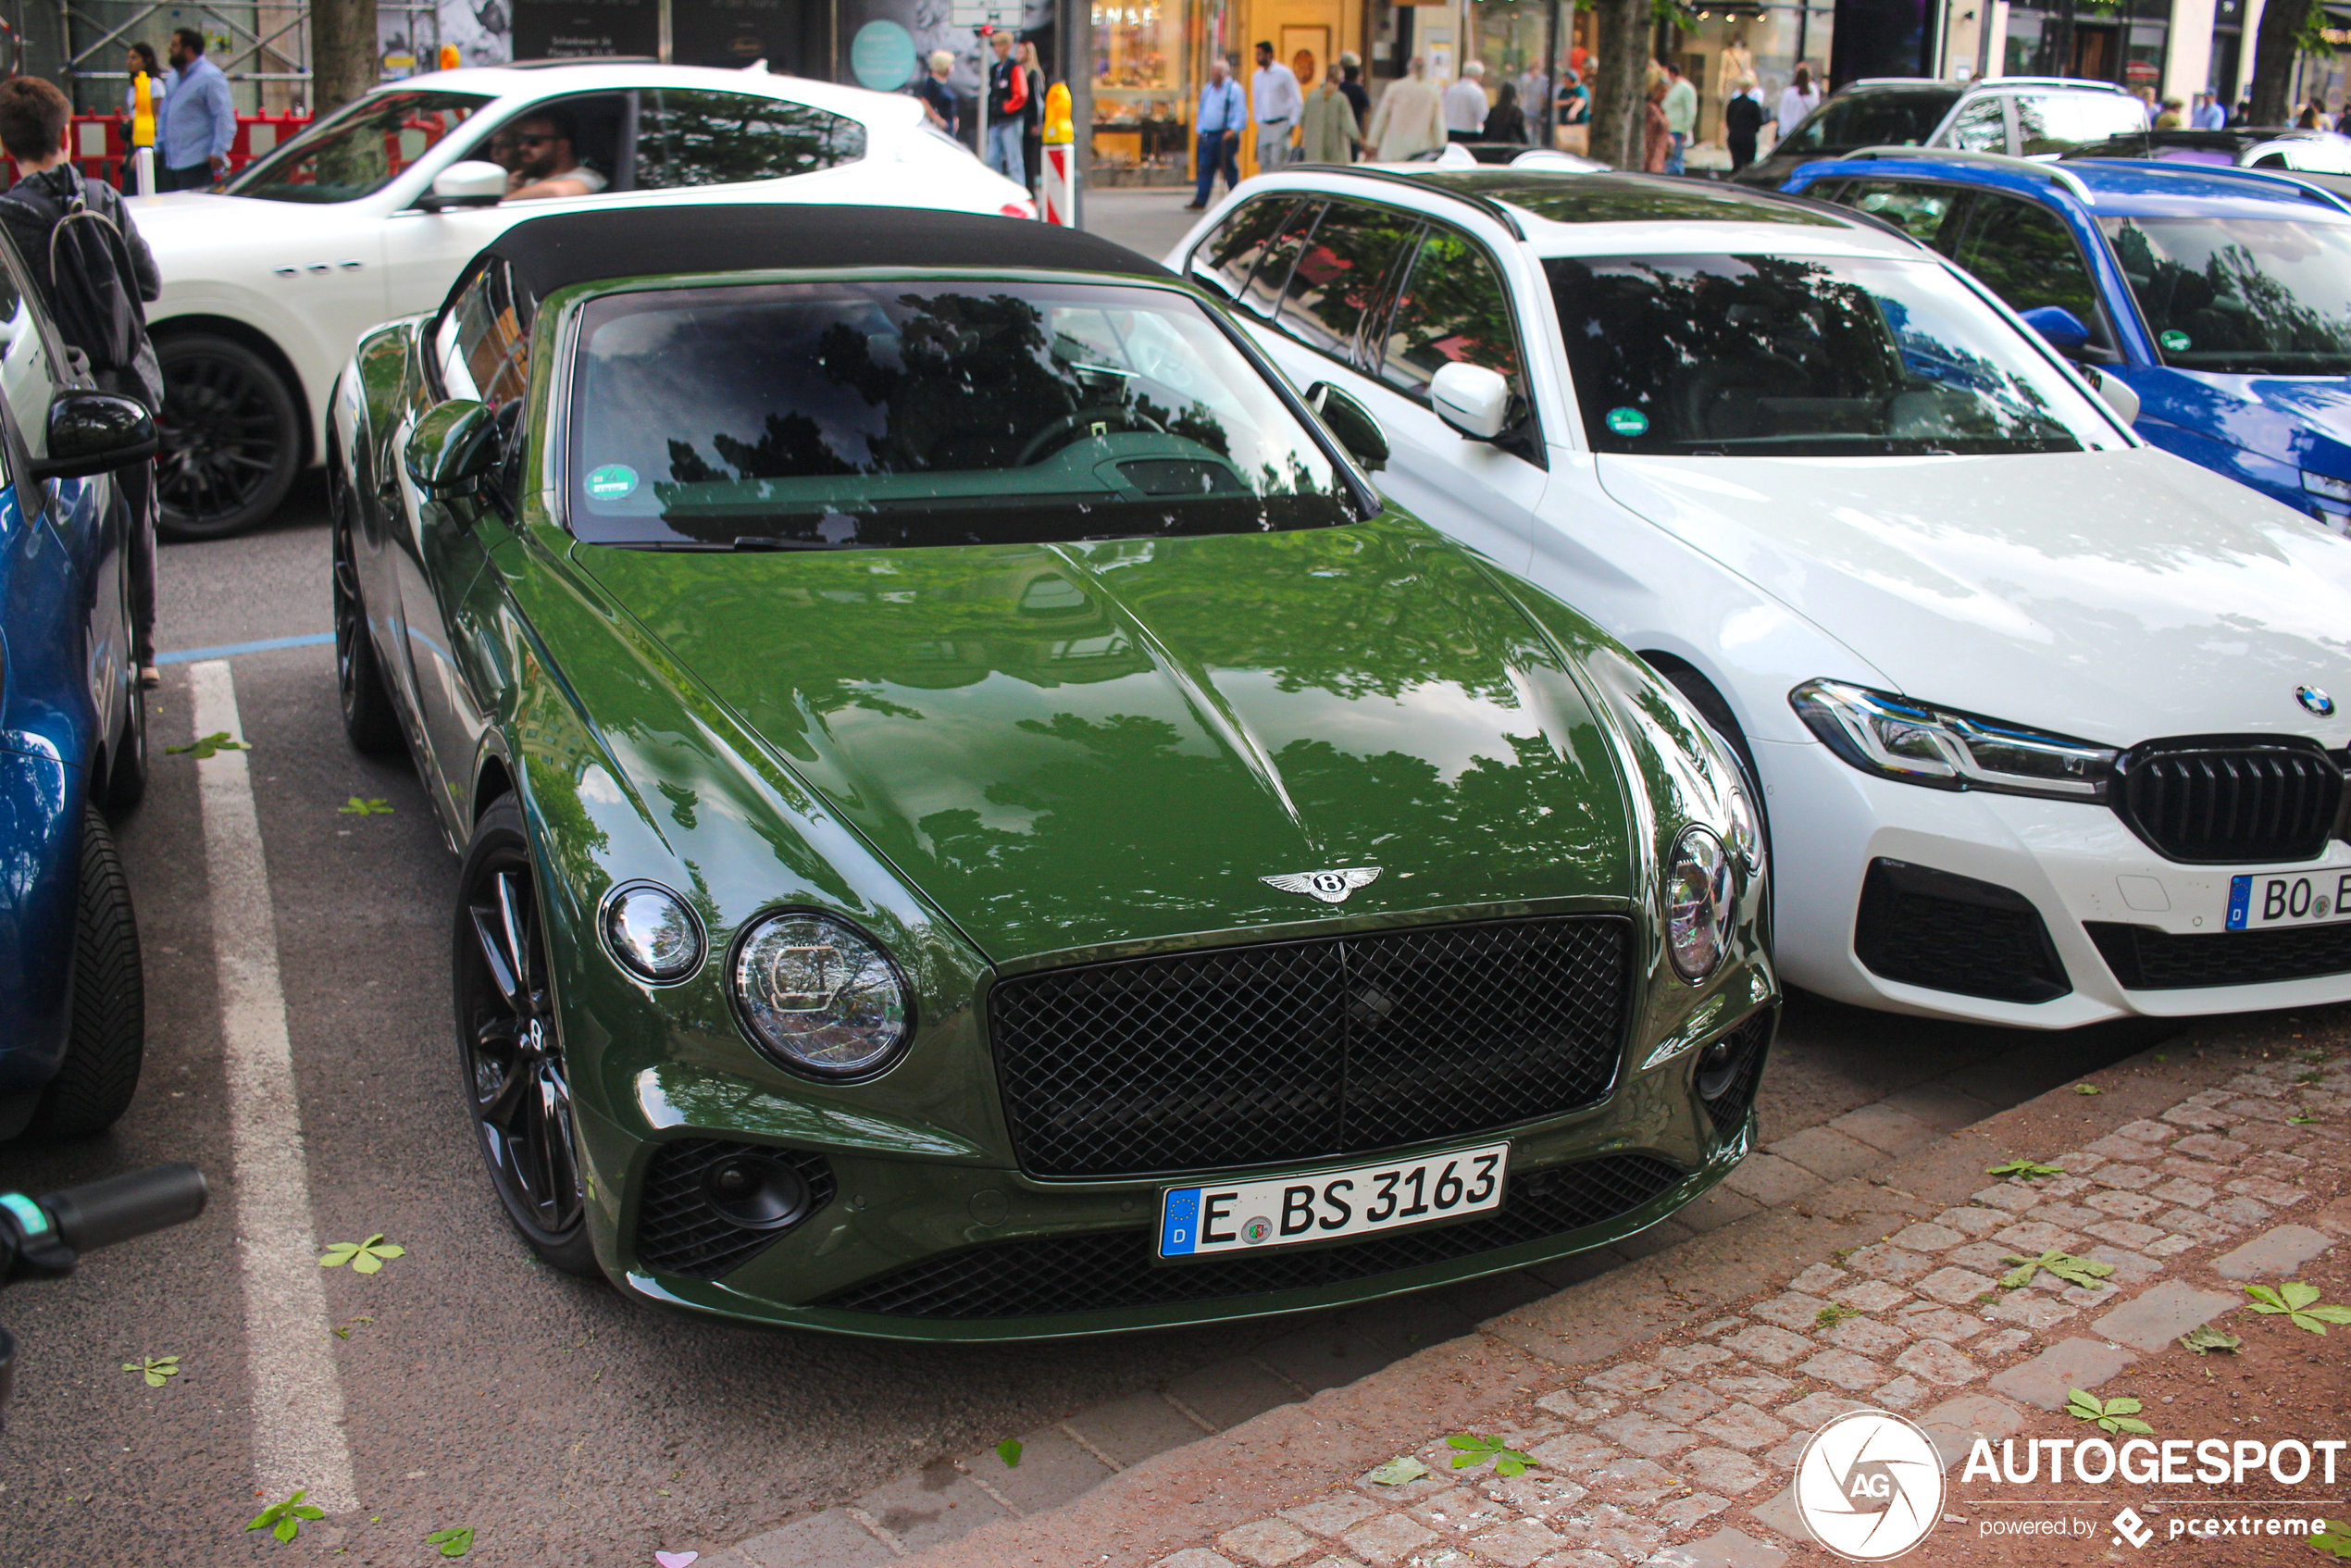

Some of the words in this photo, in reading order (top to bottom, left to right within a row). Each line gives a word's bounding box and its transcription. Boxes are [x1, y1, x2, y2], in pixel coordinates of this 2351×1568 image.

[1316, 874, 1342, 891] B
[2233, 909, 2241, 921] D
[2263, 877, 2311, 920] BO
[1174, 1229, 1186, 1244] D
[1201, 1192, 1238, 1244] E
[1279, 1179, 1354, 1237] BS
[1367, 1153, 1499, 1223] 3163
